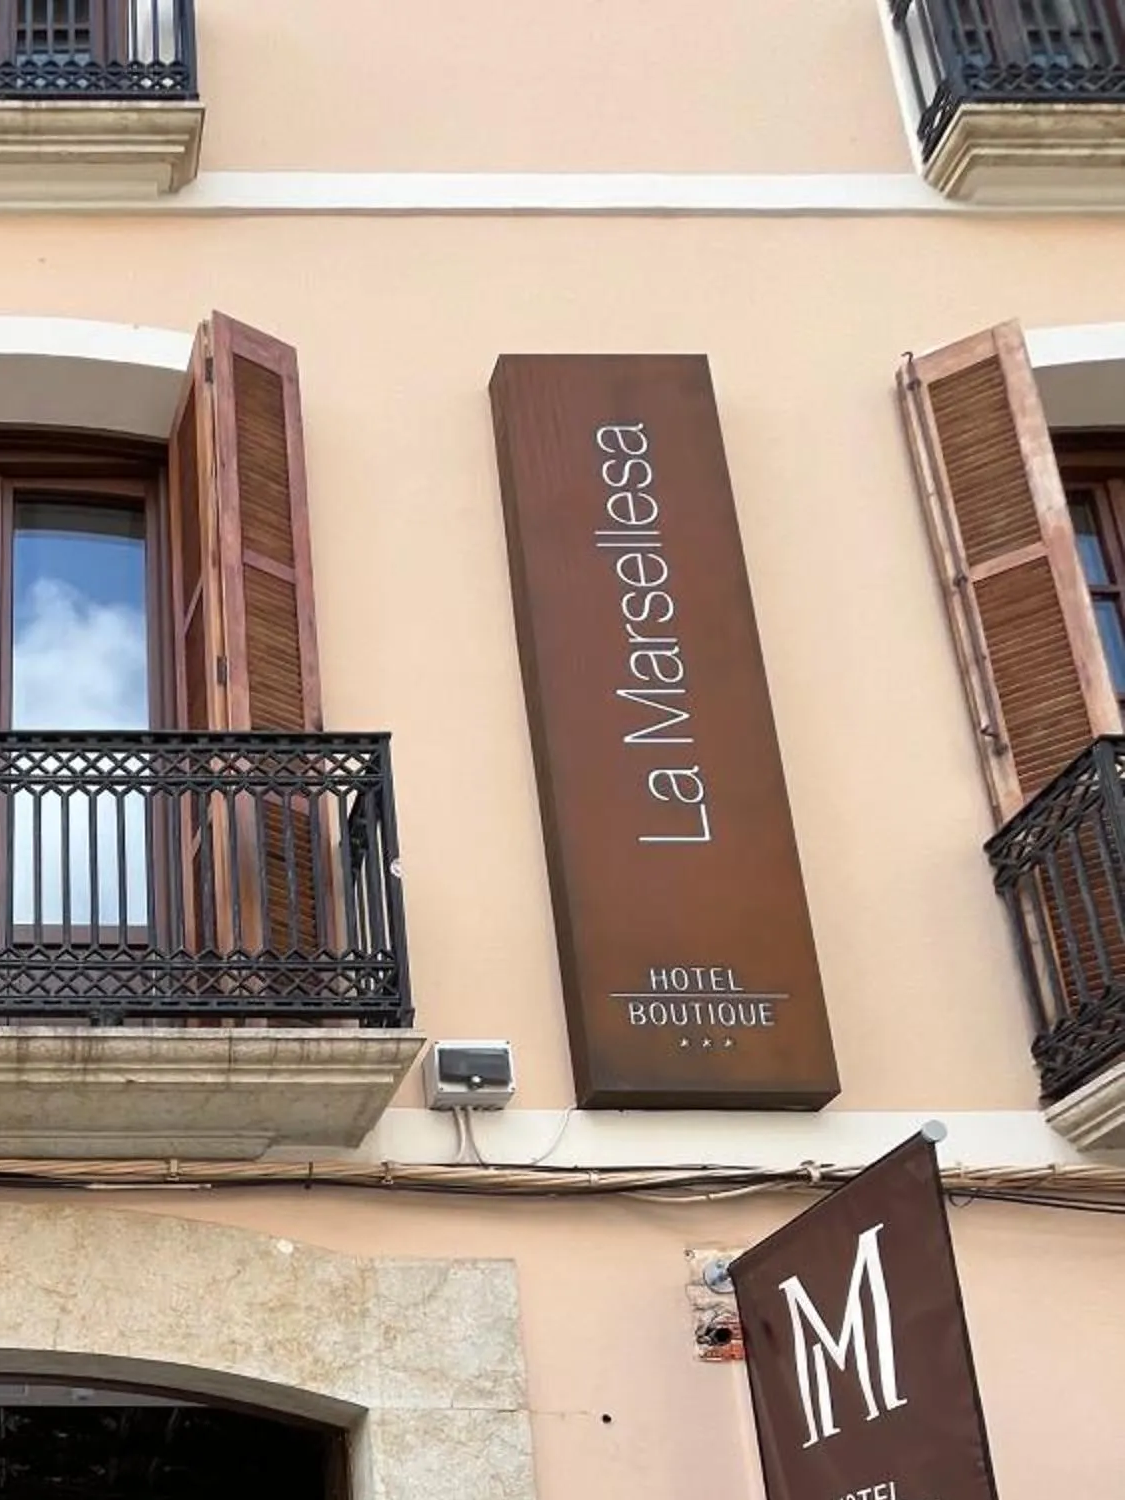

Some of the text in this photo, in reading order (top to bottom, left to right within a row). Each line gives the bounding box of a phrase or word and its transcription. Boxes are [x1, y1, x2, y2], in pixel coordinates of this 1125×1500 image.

[594, 422, 712, 843] La Marsellesa
[649, 966, 744, 993] HOTEL
[628, 1001, 775, 1028] BOUTIQUE
